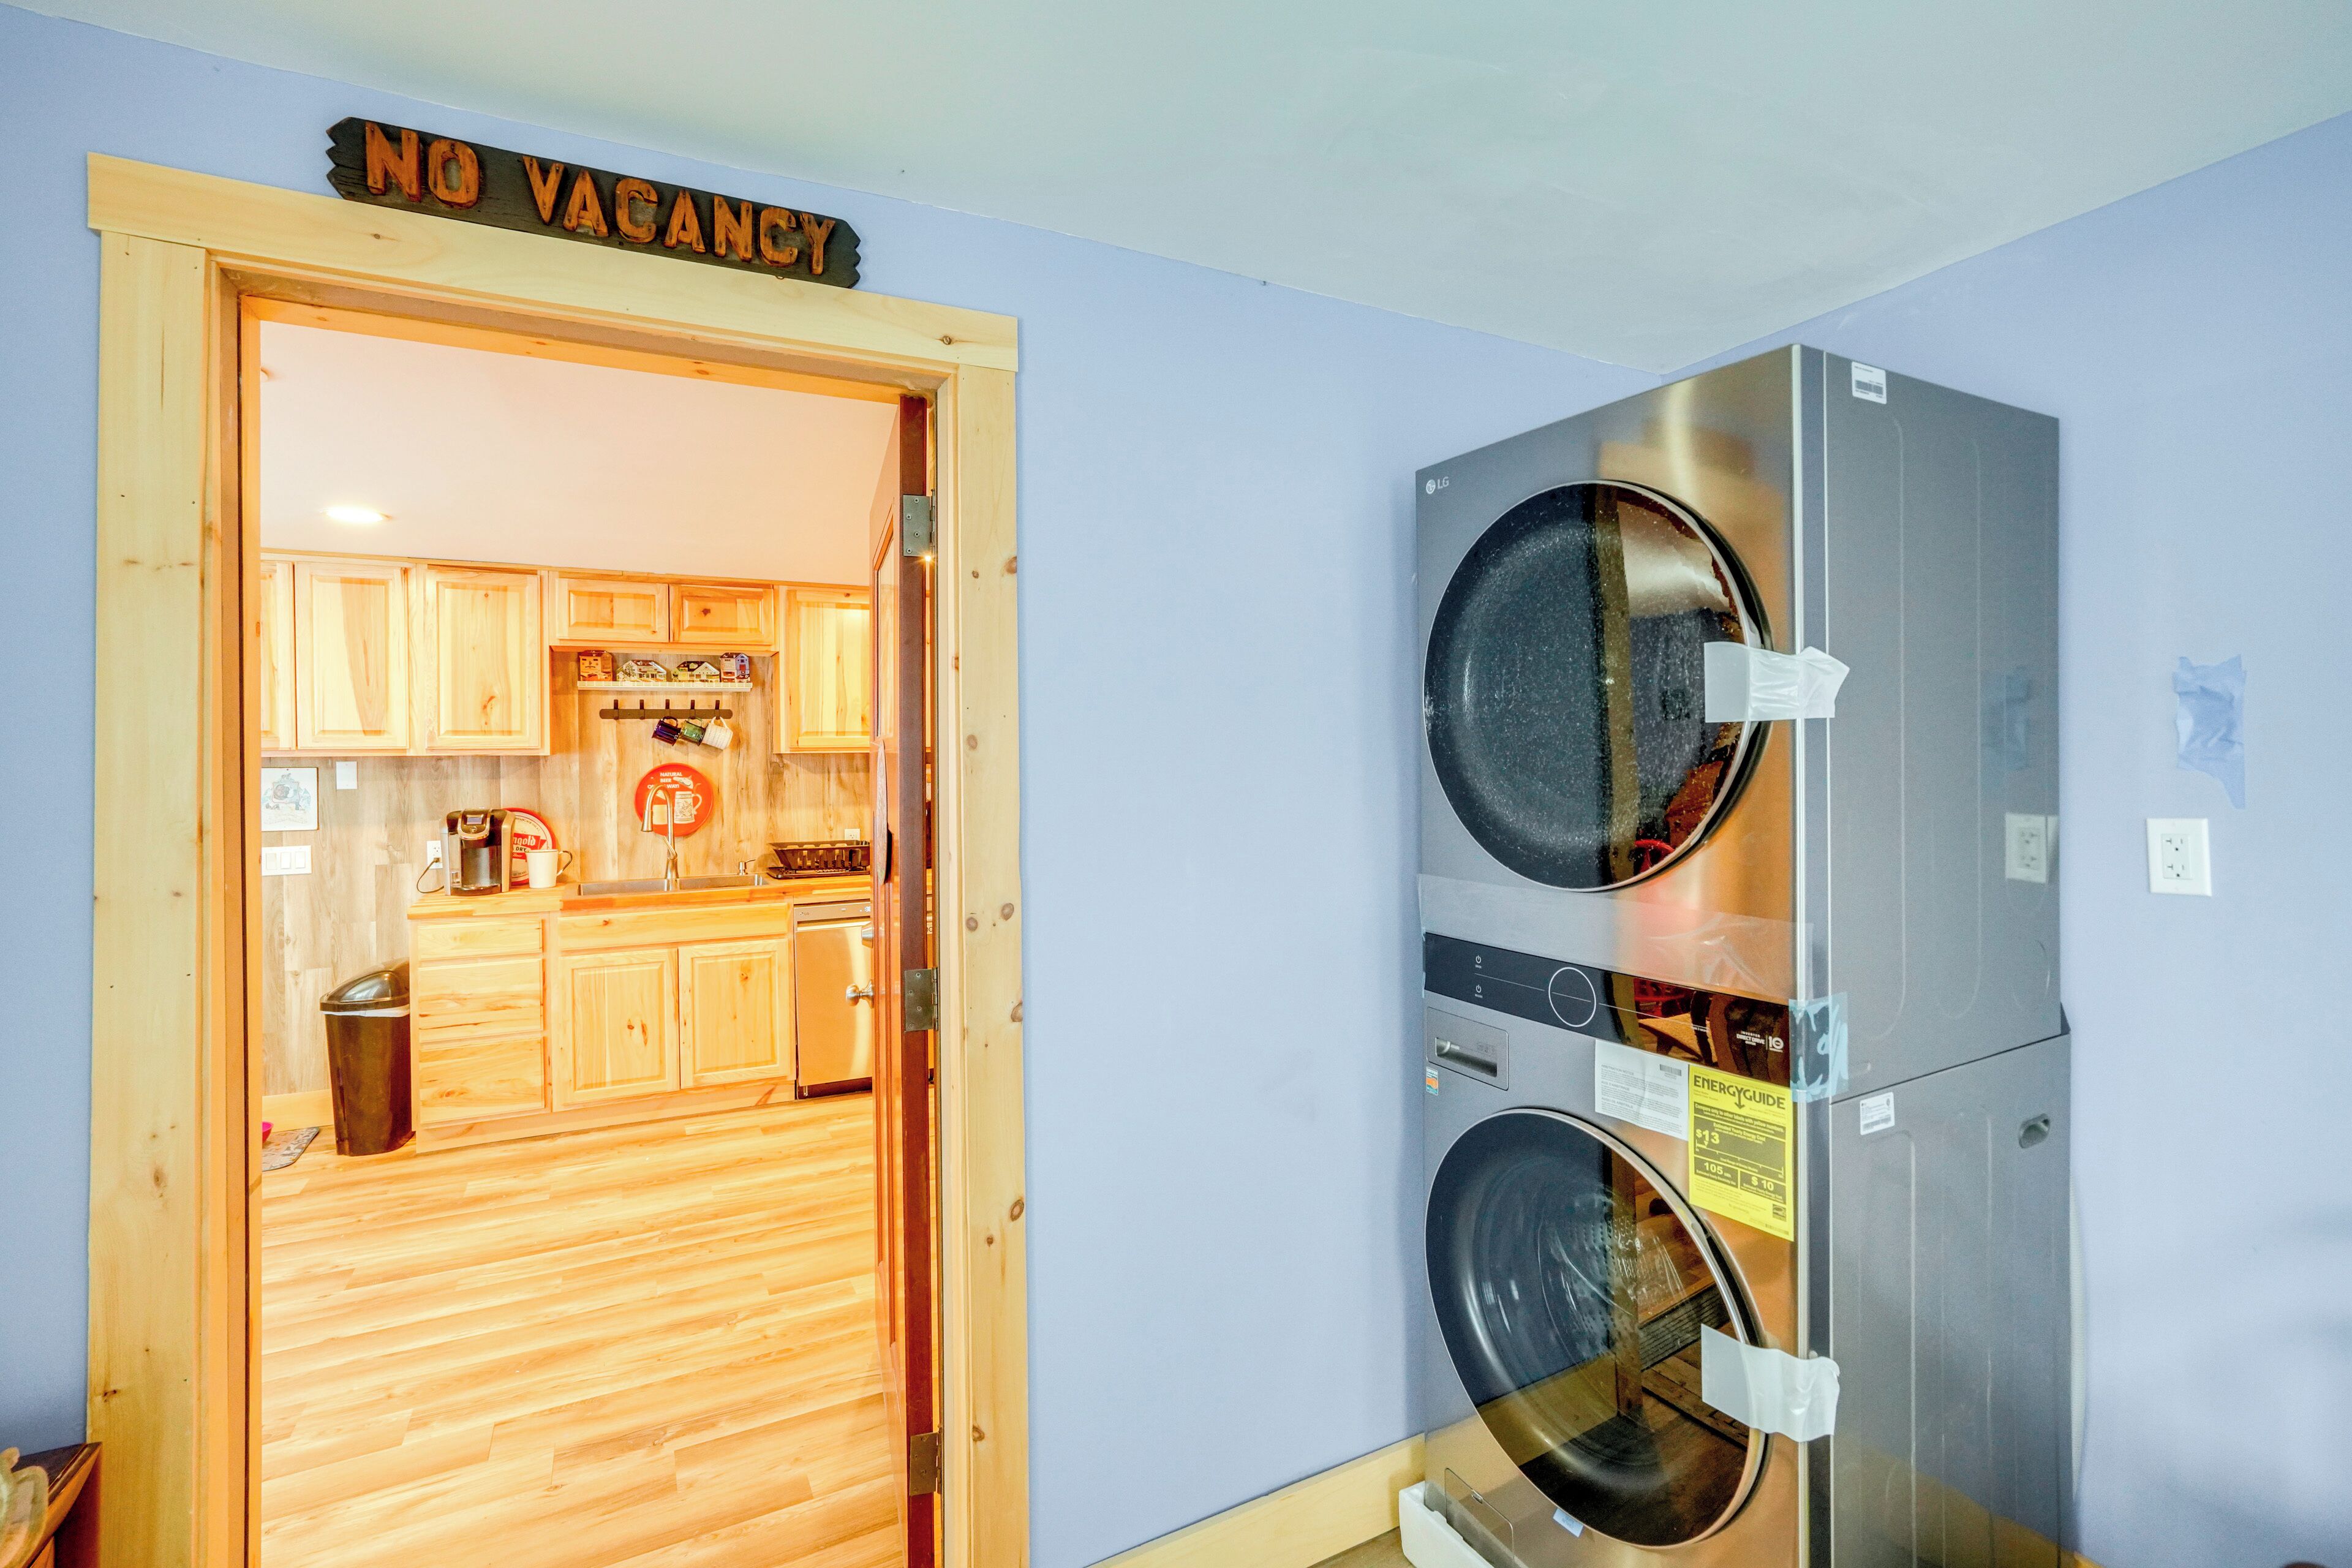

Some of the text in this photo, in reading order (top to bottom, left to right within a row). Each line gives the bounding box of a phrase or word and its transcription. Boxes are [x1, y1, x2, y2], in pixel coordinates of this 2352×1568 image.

[365, 121, 835, 276] NO VACANCY
[1438, 477, 1449, 489] LG
[1694, 1074, 1786, 1110] ENERGYGUIDE
[1695, 1128, 1720, 1145] $13
[1704, 1162, 1723, 1175] 105
[1762, 1180, 1774, 1191] 10
